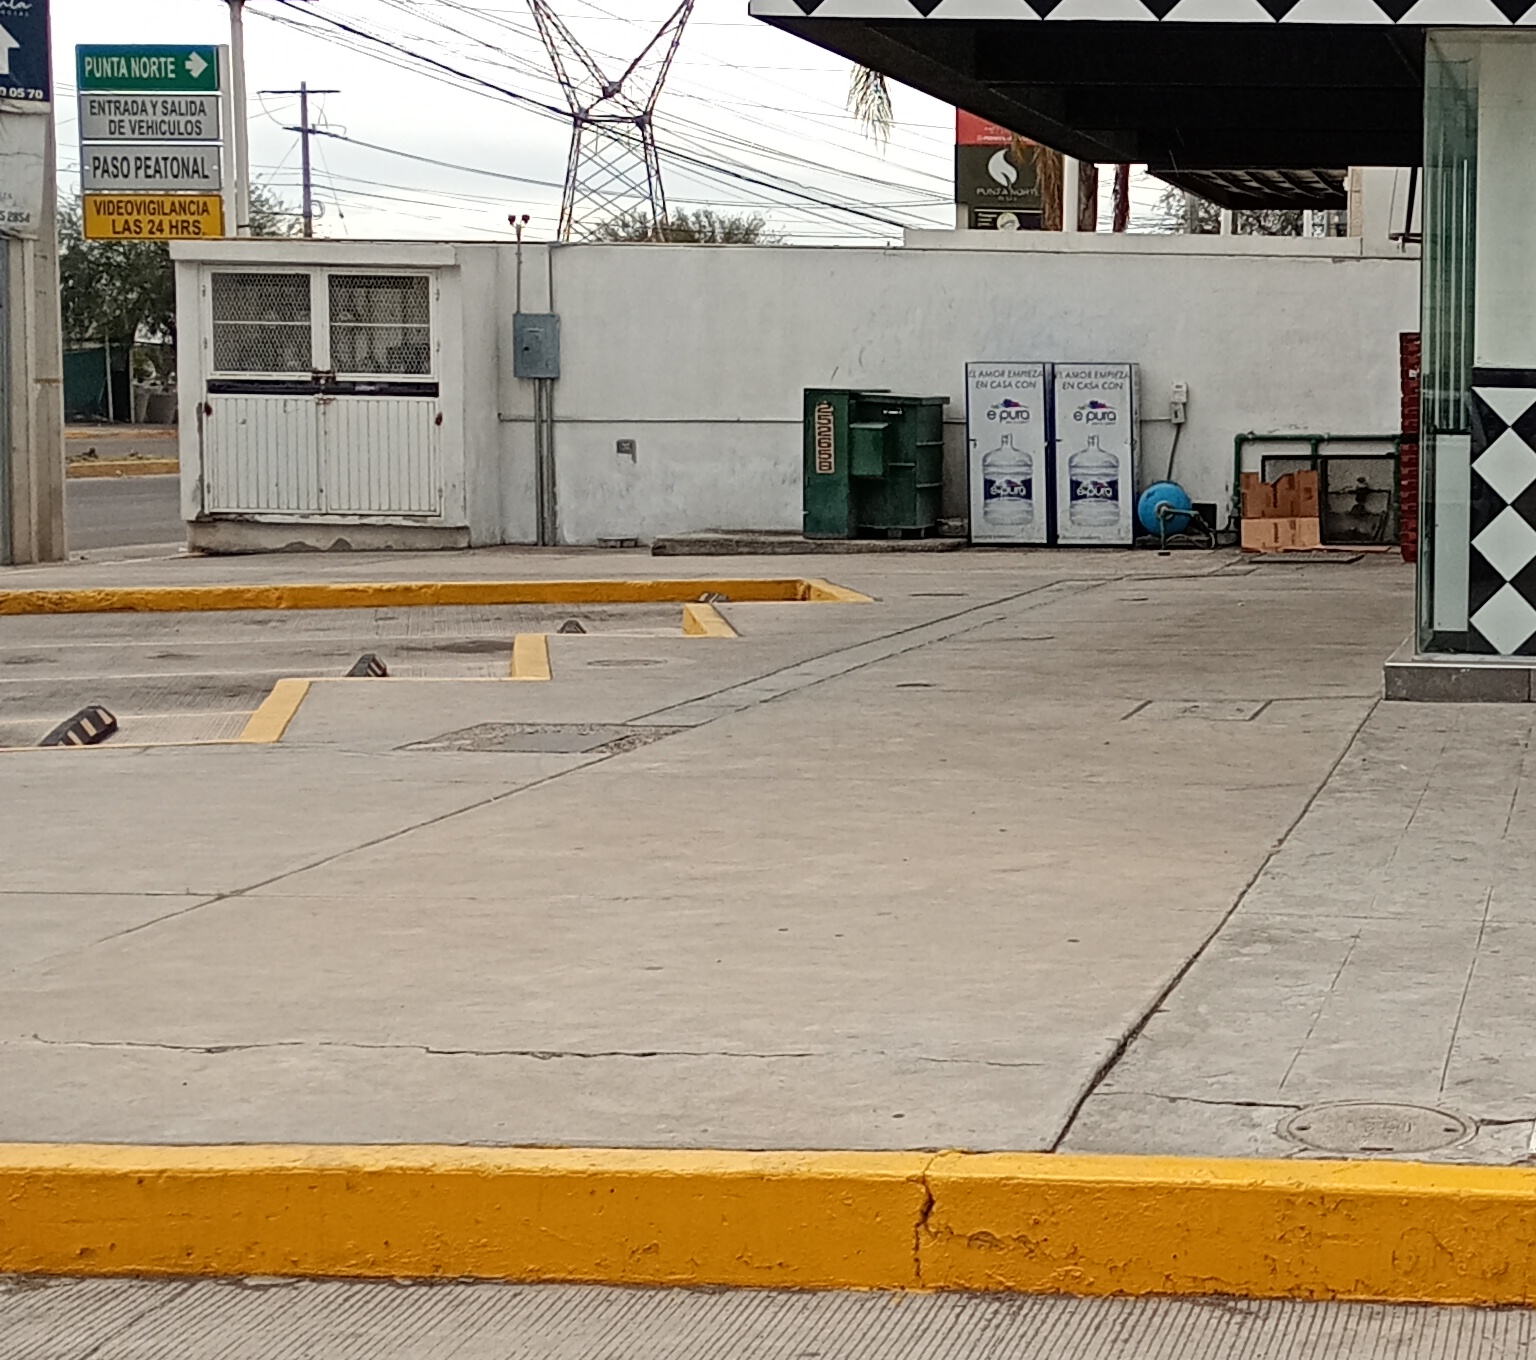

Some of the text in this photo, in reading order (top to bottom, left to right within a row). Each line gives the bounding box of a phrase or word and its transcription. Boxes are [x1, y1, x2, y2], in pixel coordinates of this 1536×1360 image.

[84, 57, 176, 78] PUNTA NORTE
[9, 88, 25, 98] 05
[27, 89, 43, 99] 70
[90, 100, 207, 116] ENTRADA Y SALIDA
[109, 120, 203, 136] DE VEHICULOS
[92, 156, 209, 179] PASO PEATONAL
[93, 200, 210, 216] VIDEOVIGILANCIA
[112, 219, 142, 235] LAS
[147, 219, 164, 235] 24
[978, 370, 1006, 378] AMOR
[975, 381, 1037, 389] EN CASA CON
[1062, 382, 1123, 390] EN CASA CON
